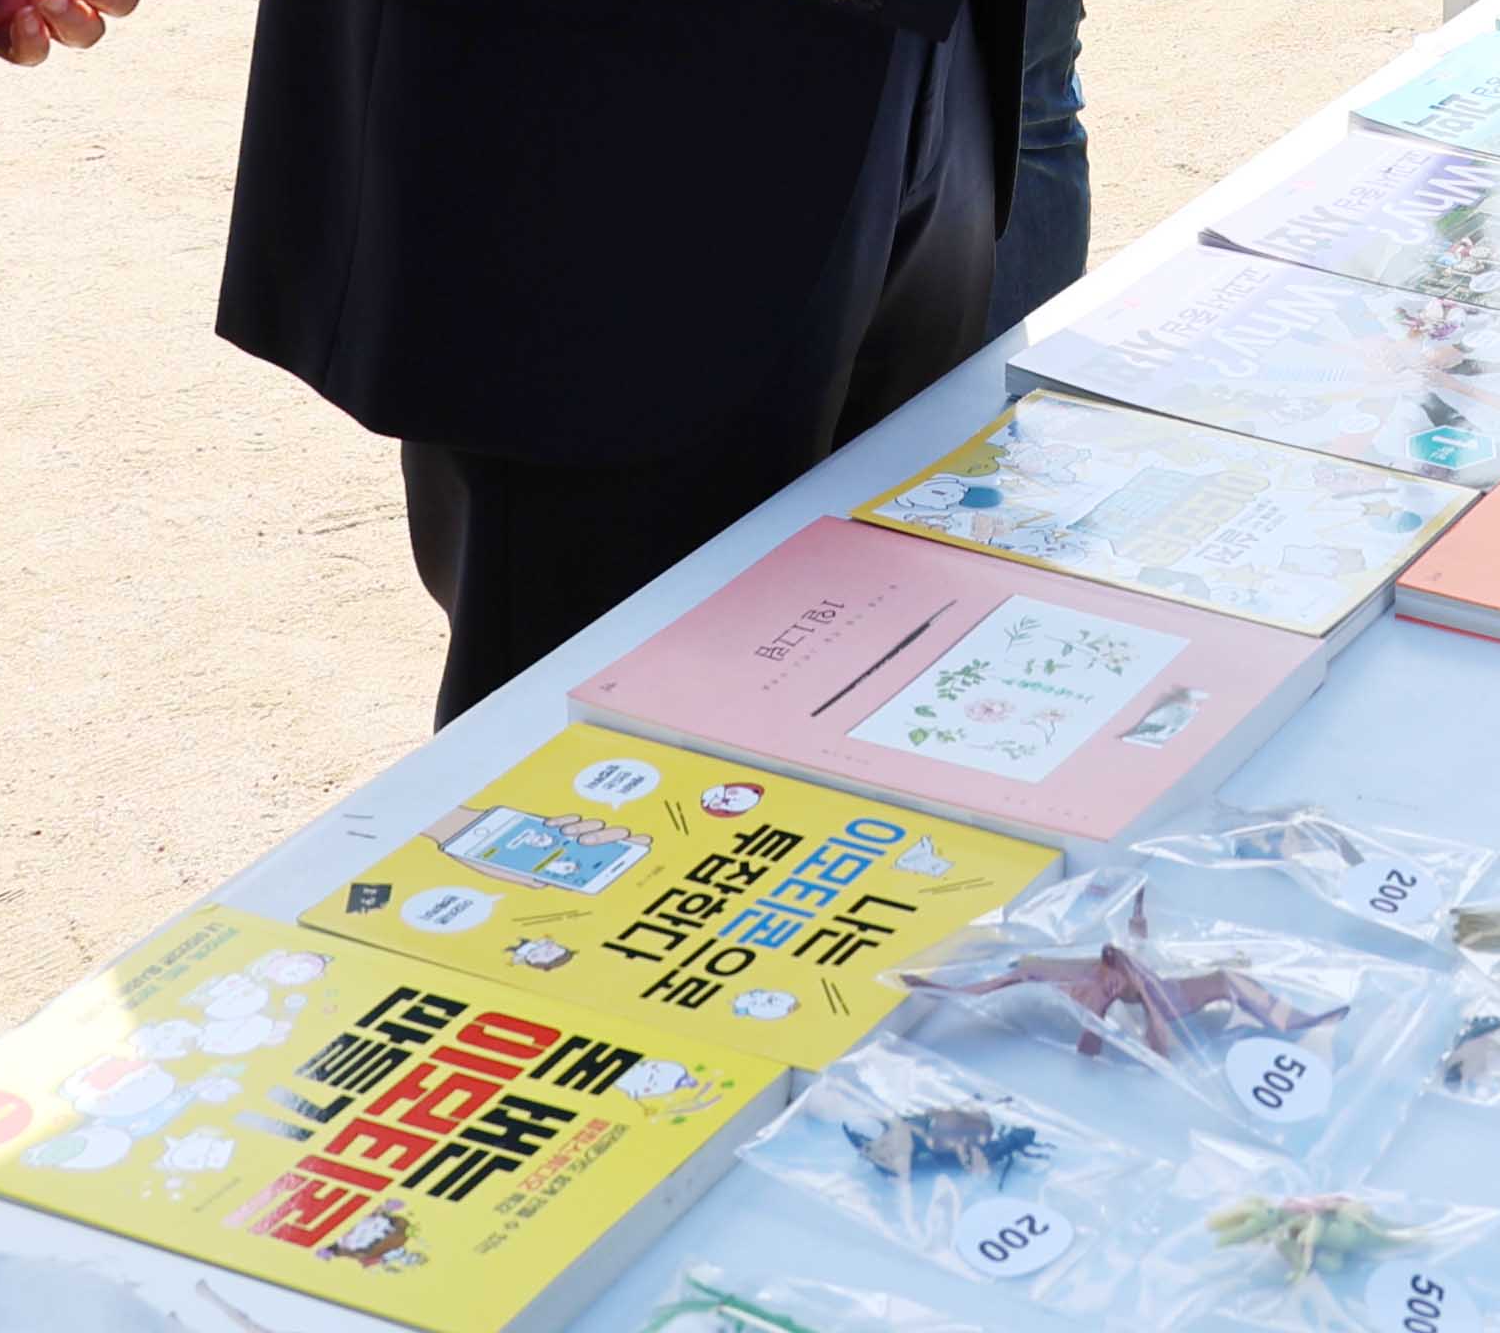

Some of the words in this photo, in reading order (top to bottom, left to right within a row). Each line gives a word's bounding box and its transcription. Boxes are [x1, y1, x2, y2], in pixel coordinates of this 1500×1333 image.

[1204, 282, 1349, 381] Why?
[601, 823, 804, 965] 투잡한다
[639, 817, 907, 1012] 이모티콘으로
[794, 894, 919, 968] 나는
[1369, 869, 1418, 914] 200
[232, 985, 470, 1142] 만들기
[528, 1035, 645, 1095] 돈
[1251, 1053, 1307, 1110] 500
[226, 1011, 563, 1250] 이모티콘
[400, 1095, 579, 1203] 버는
[977, 1213, 1051, 1263] 200
